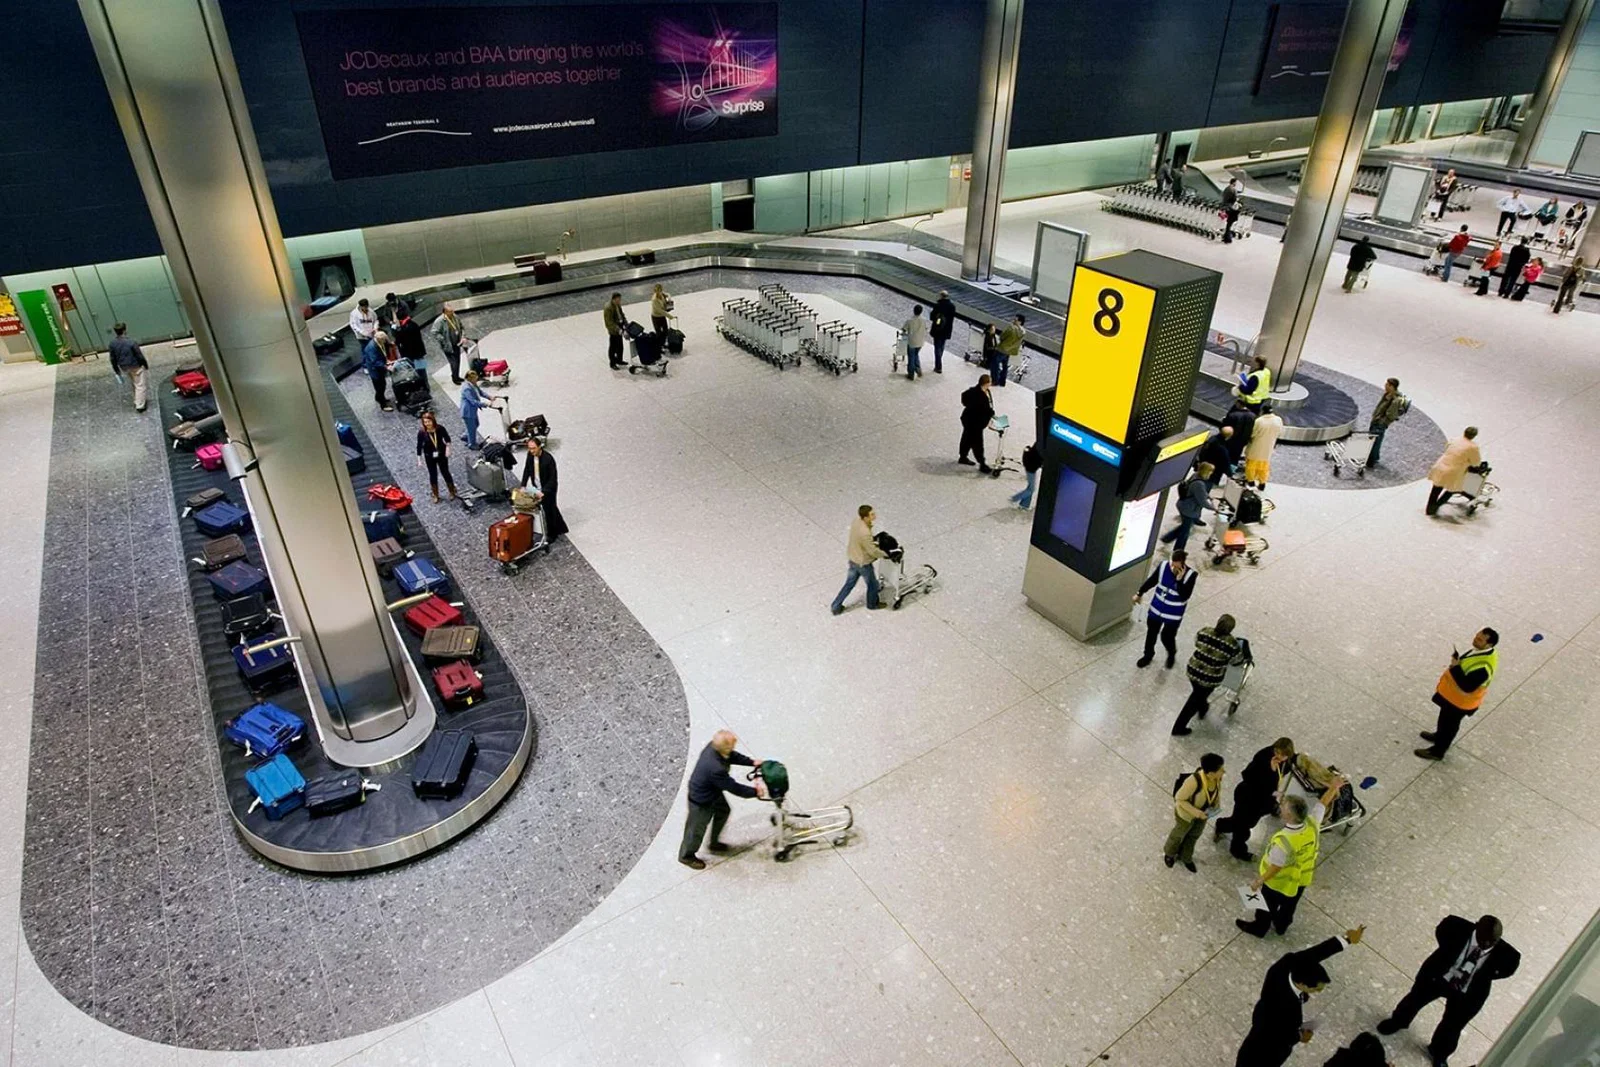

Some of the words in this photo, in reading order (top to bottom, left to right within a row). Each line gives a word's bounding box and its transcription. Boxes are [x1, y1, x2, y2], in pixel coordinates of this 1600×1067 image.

[339, 50, 431, 71] JCDecaux
[434, 46, 466, 65] and
[469, 45, 506, 64] BAA
[507, 43, 567, 64] bringing
[570, 43, 593, 59] the
[597, 40, 644, 57] world's
[344, 78, 385, 97] best
[388, 74, 447, 94] brands
[451, 71, 482, 90] and
[485, 69, 562, 88] audiences
[566, 65, 622, 85] together
[722, 98, 765, 115] Surprise
[1093, 287, 1124, 338] 8
[1053, 423, 1083, 444] Customs
